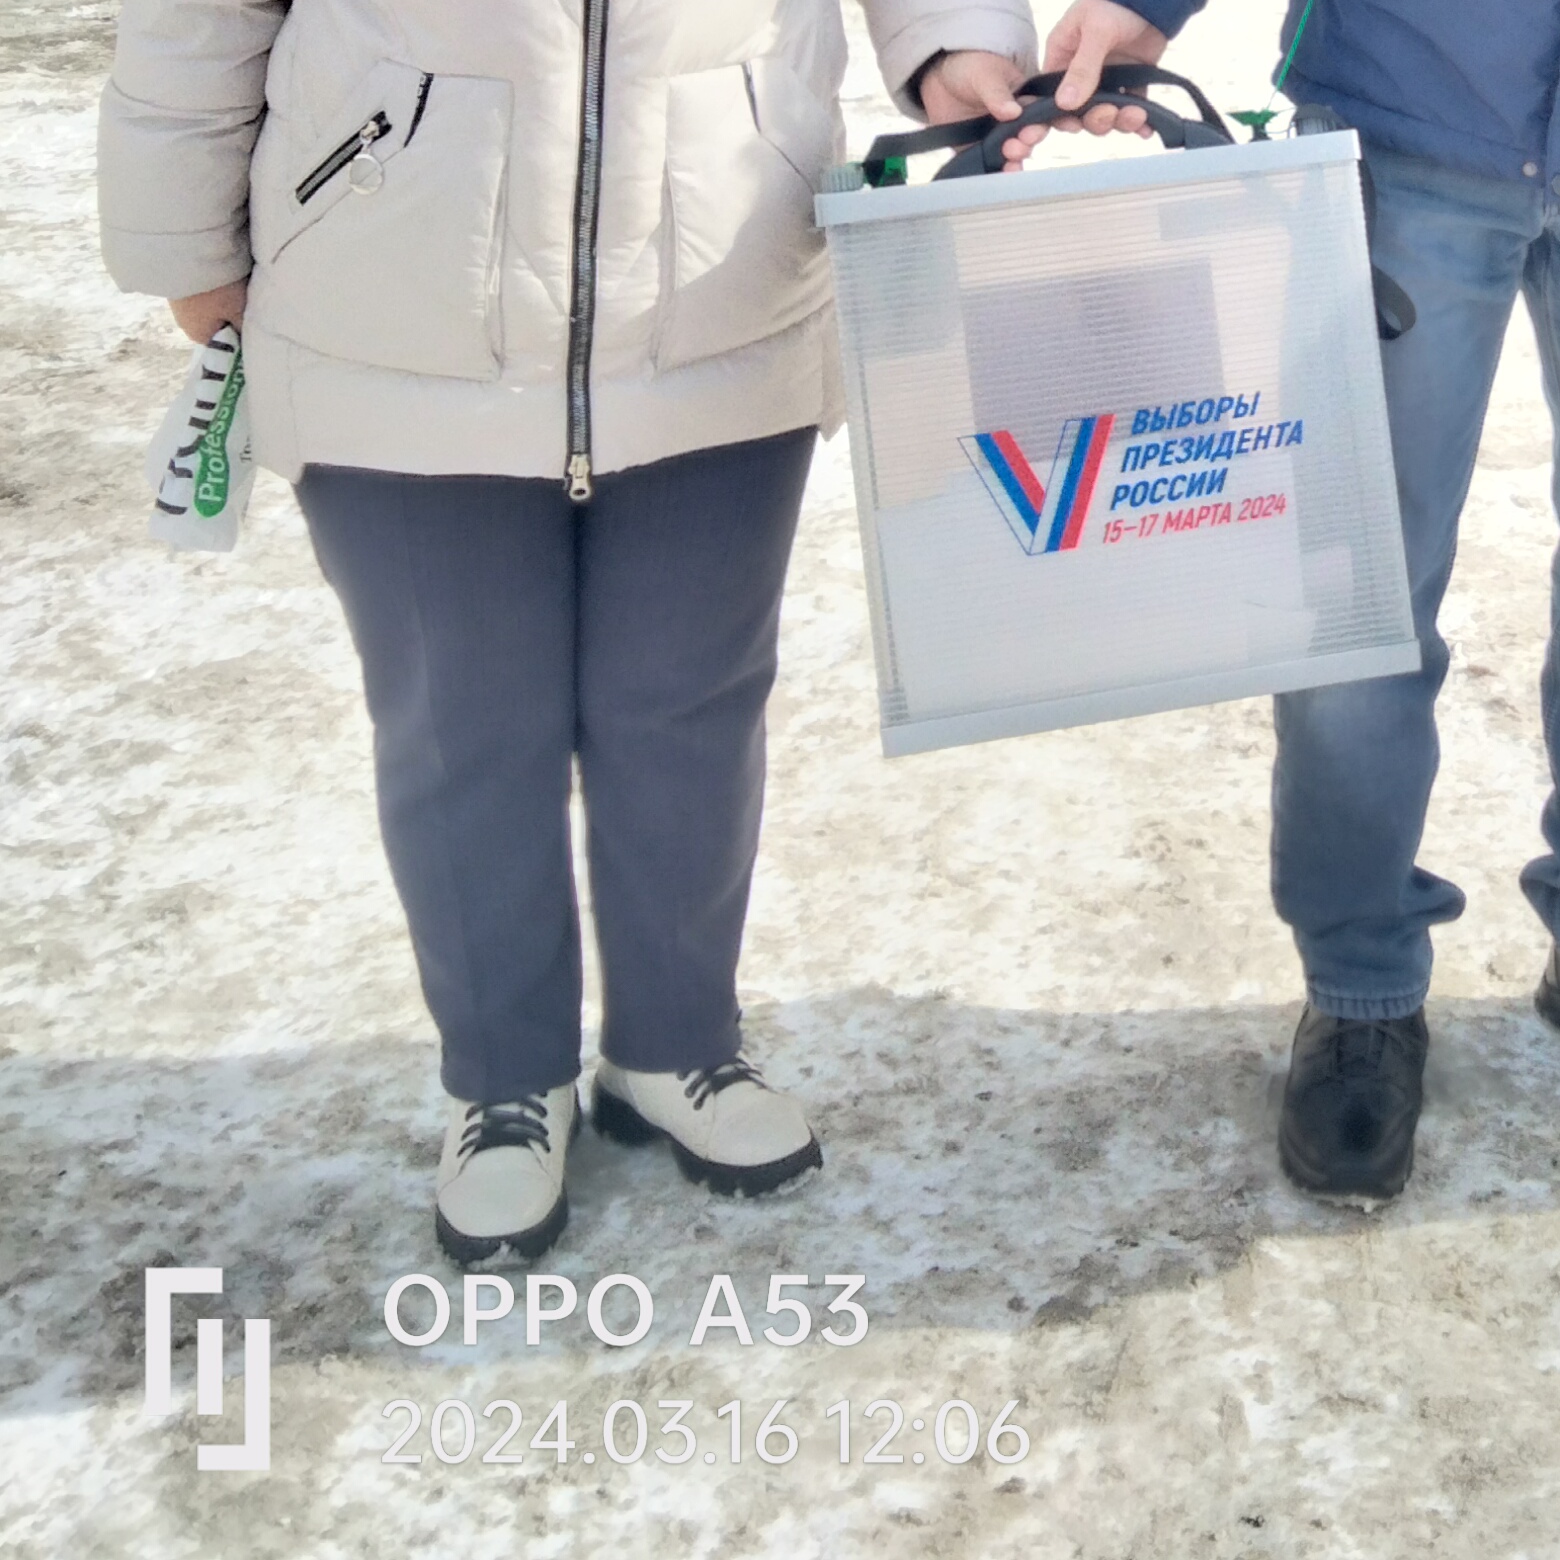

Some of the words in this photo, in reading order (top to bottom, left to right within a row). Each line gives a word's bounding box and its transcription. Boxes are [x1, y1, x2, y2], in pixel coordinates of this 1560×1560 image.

[198, 359, 244, 503] Profession
[1131, 391, 1261, 436] ВЫБОРЫ
[1120, 419, 1304, 474] ПРЕЗИДЕНТА
[1110, 467, 1229, 512] РОССИИ
[1162, 501, 1232, 534] МАРТА
[1237, 492, 1287, 522] 2024
